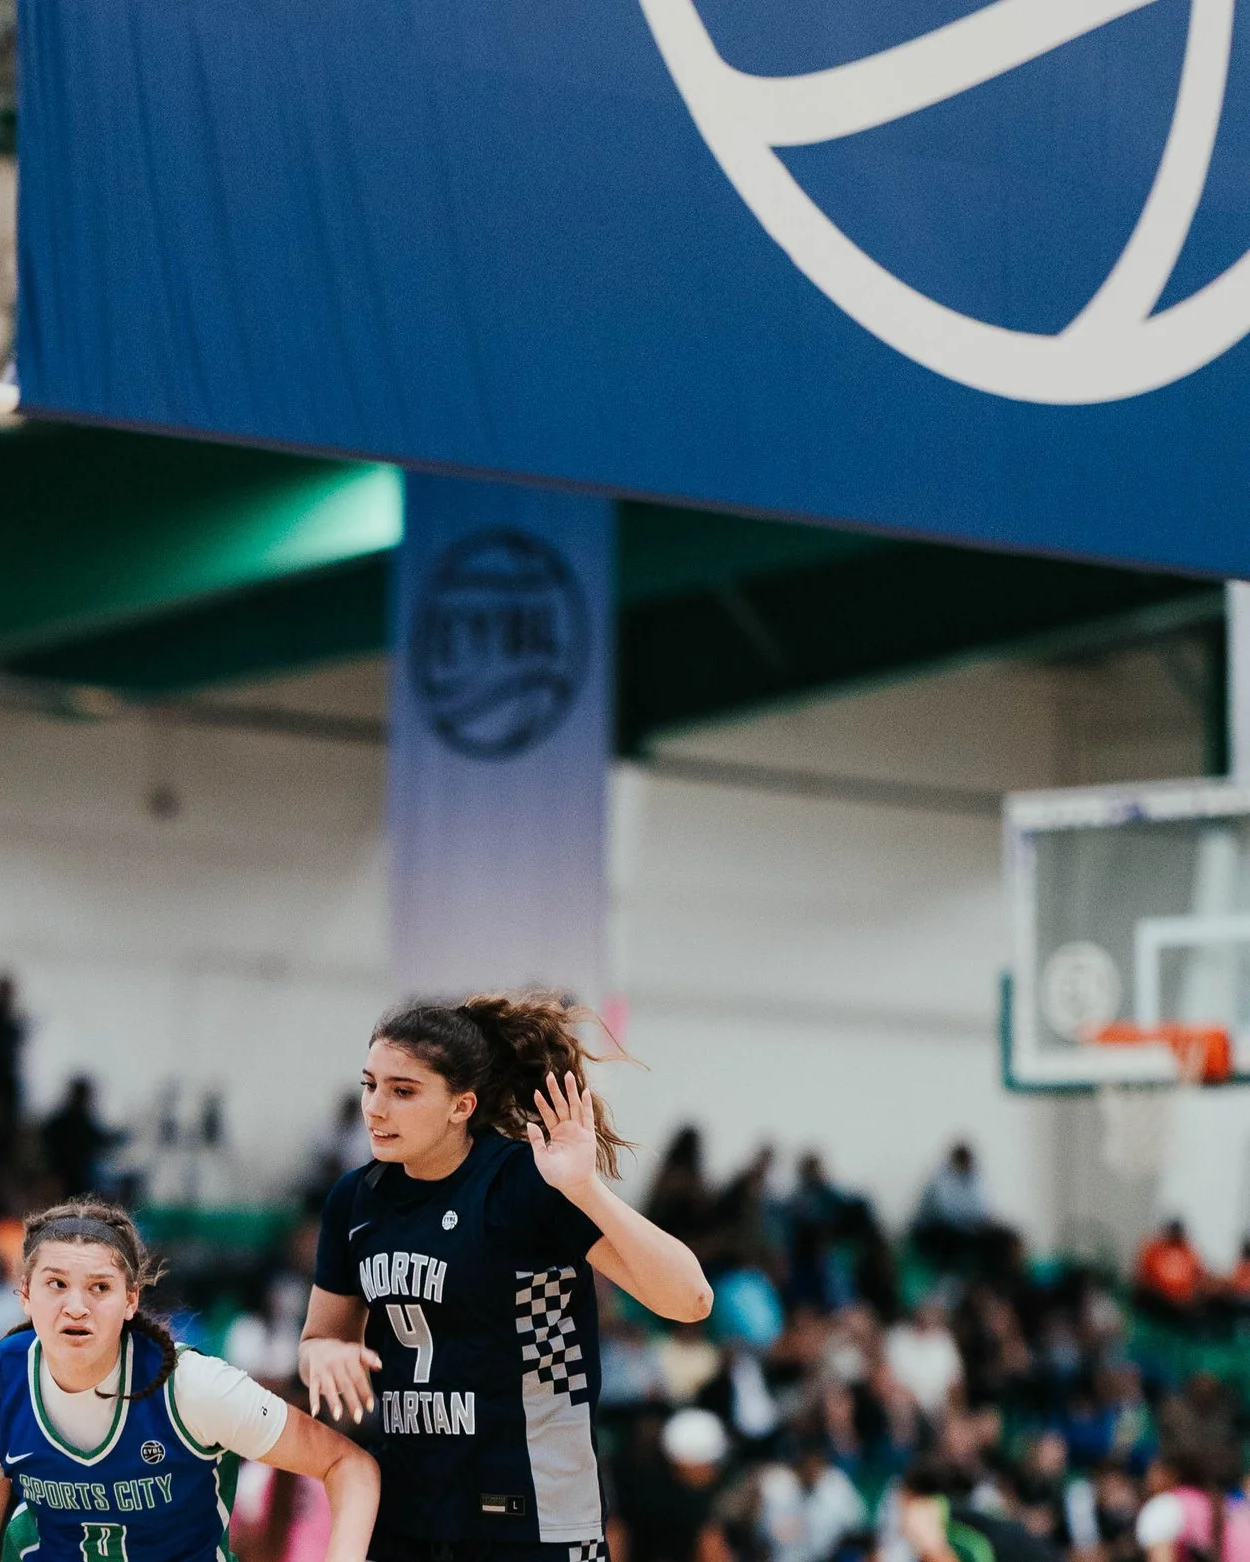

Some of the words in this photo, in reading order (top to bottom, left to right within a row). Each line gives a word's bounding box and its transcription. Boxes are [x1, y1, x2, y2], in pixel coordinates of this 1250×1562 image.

[359, 1251, 448, 1303] NORTH
[385, 1303, 434, 1383] 4
[382, 1390, 476, 1435] TARTAN
[19, 1473, 110, 1511] SPORTS
[113, 1472, 173, 1512] CITY
